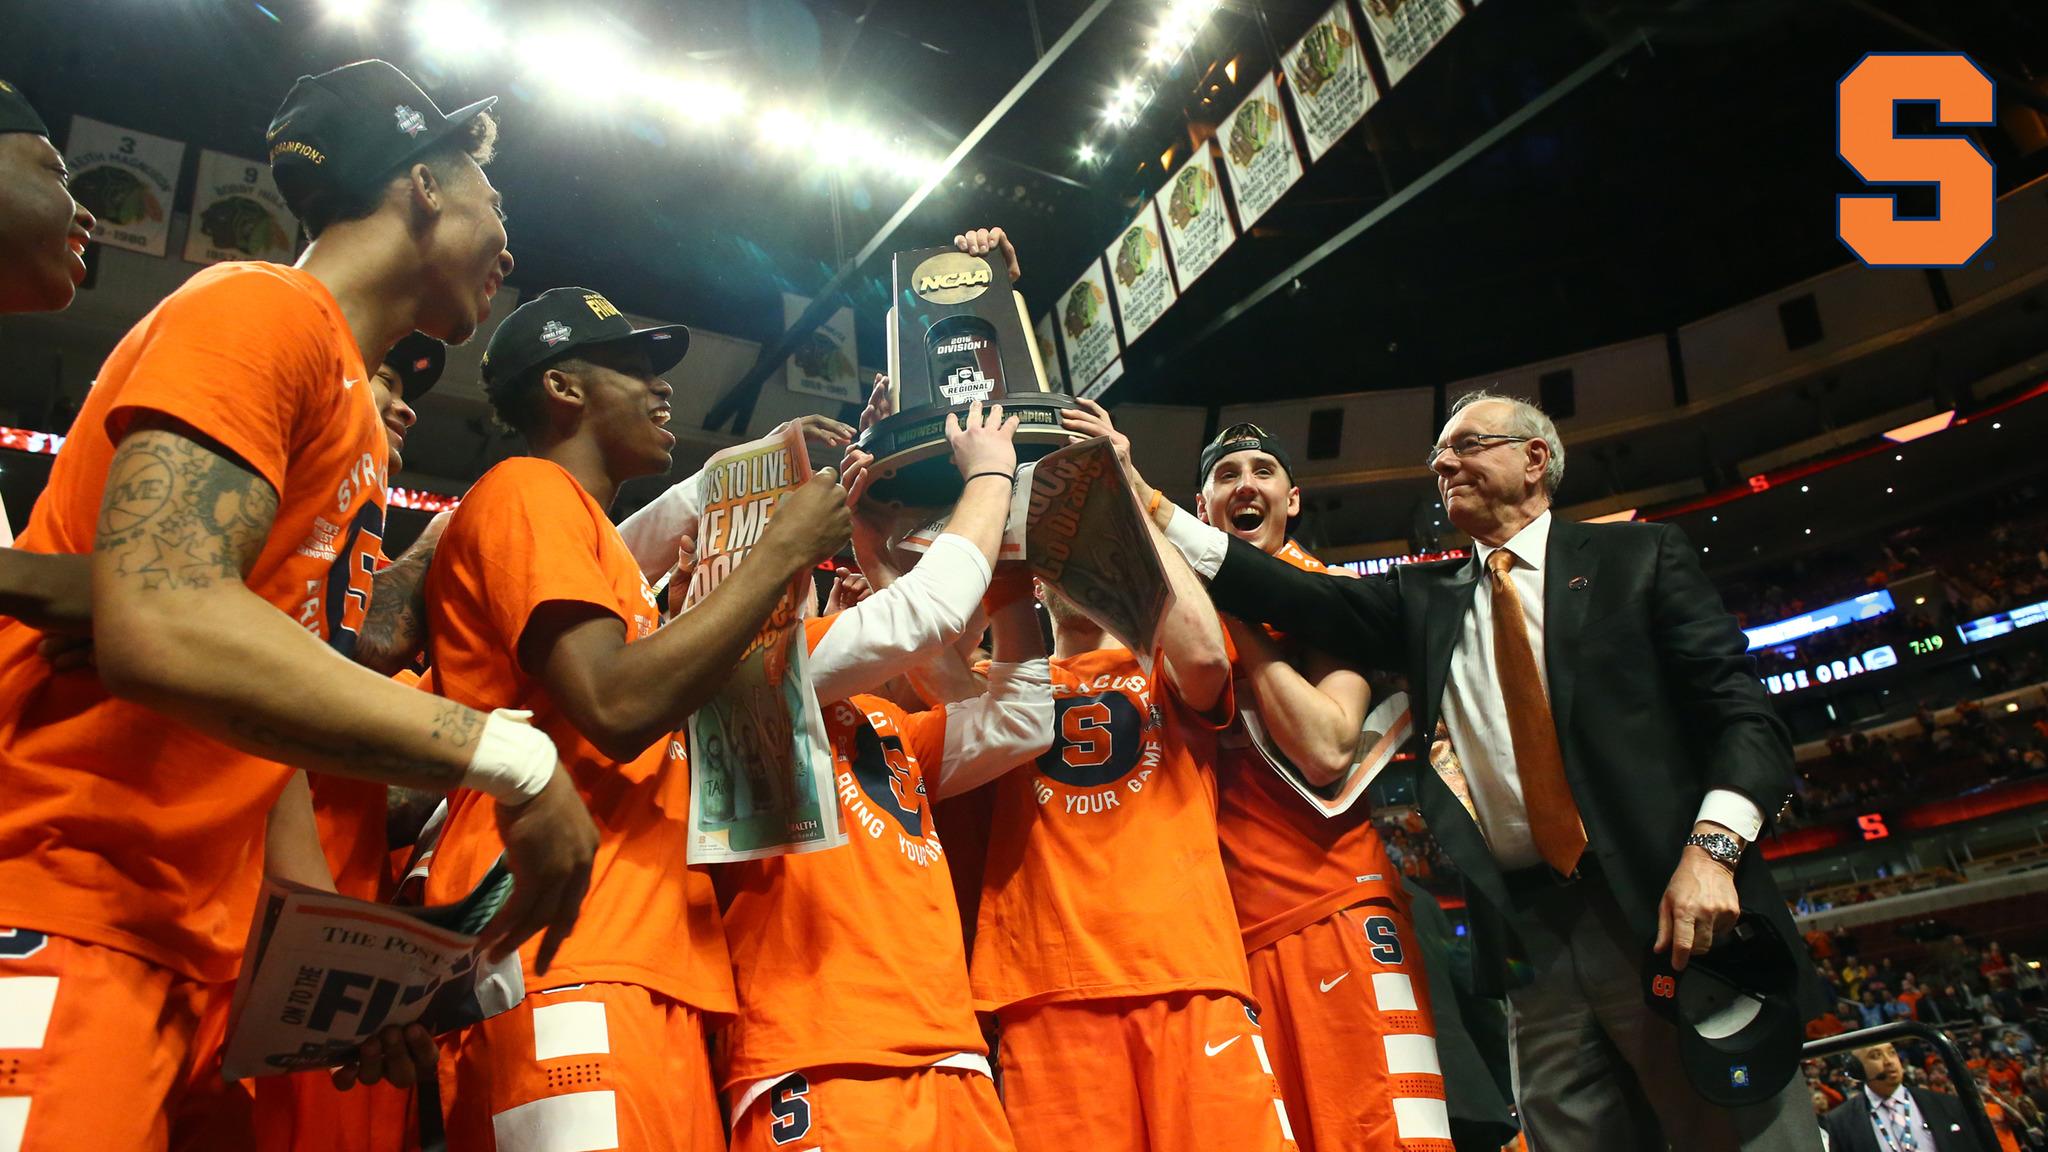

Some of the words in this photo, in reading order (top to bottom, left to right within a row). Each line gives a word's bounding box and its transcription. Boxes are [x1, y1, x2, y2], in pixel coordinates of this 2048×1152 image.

[119, 136, 136, 154] 3
[244, 167, 258, 183] 9
[919, 269, 990, 293] NCAA
[937, 341, 982, 355] DIVISION
[947, 383, 989, 394] REGIONAL
[899, 421, 945, 442] MIDWEST
[726, 459, 748, 500] TO
[751, 448, 790, 494] LIVE
[1909, 635, 1944, 655] 7:19
[1052, 675, 1150, 711] RACUSE
[1062, 702, 1112, 768] S
[1065, 790, 1121, 815] YOUR
[1127, 740, 1162, 793] GAME
[1857, 813, 1890, 841] S
[322, 926, 377, 948] THE
[1363, 915, 1404, 966] S
[295, 964, 323, 993] THE
[1652, 974, 1675, 999] S
[287, 987, 314, 1006] TO
[280, 1006, 306, 1026] ON
[770, 1073, 810, 1145] S
